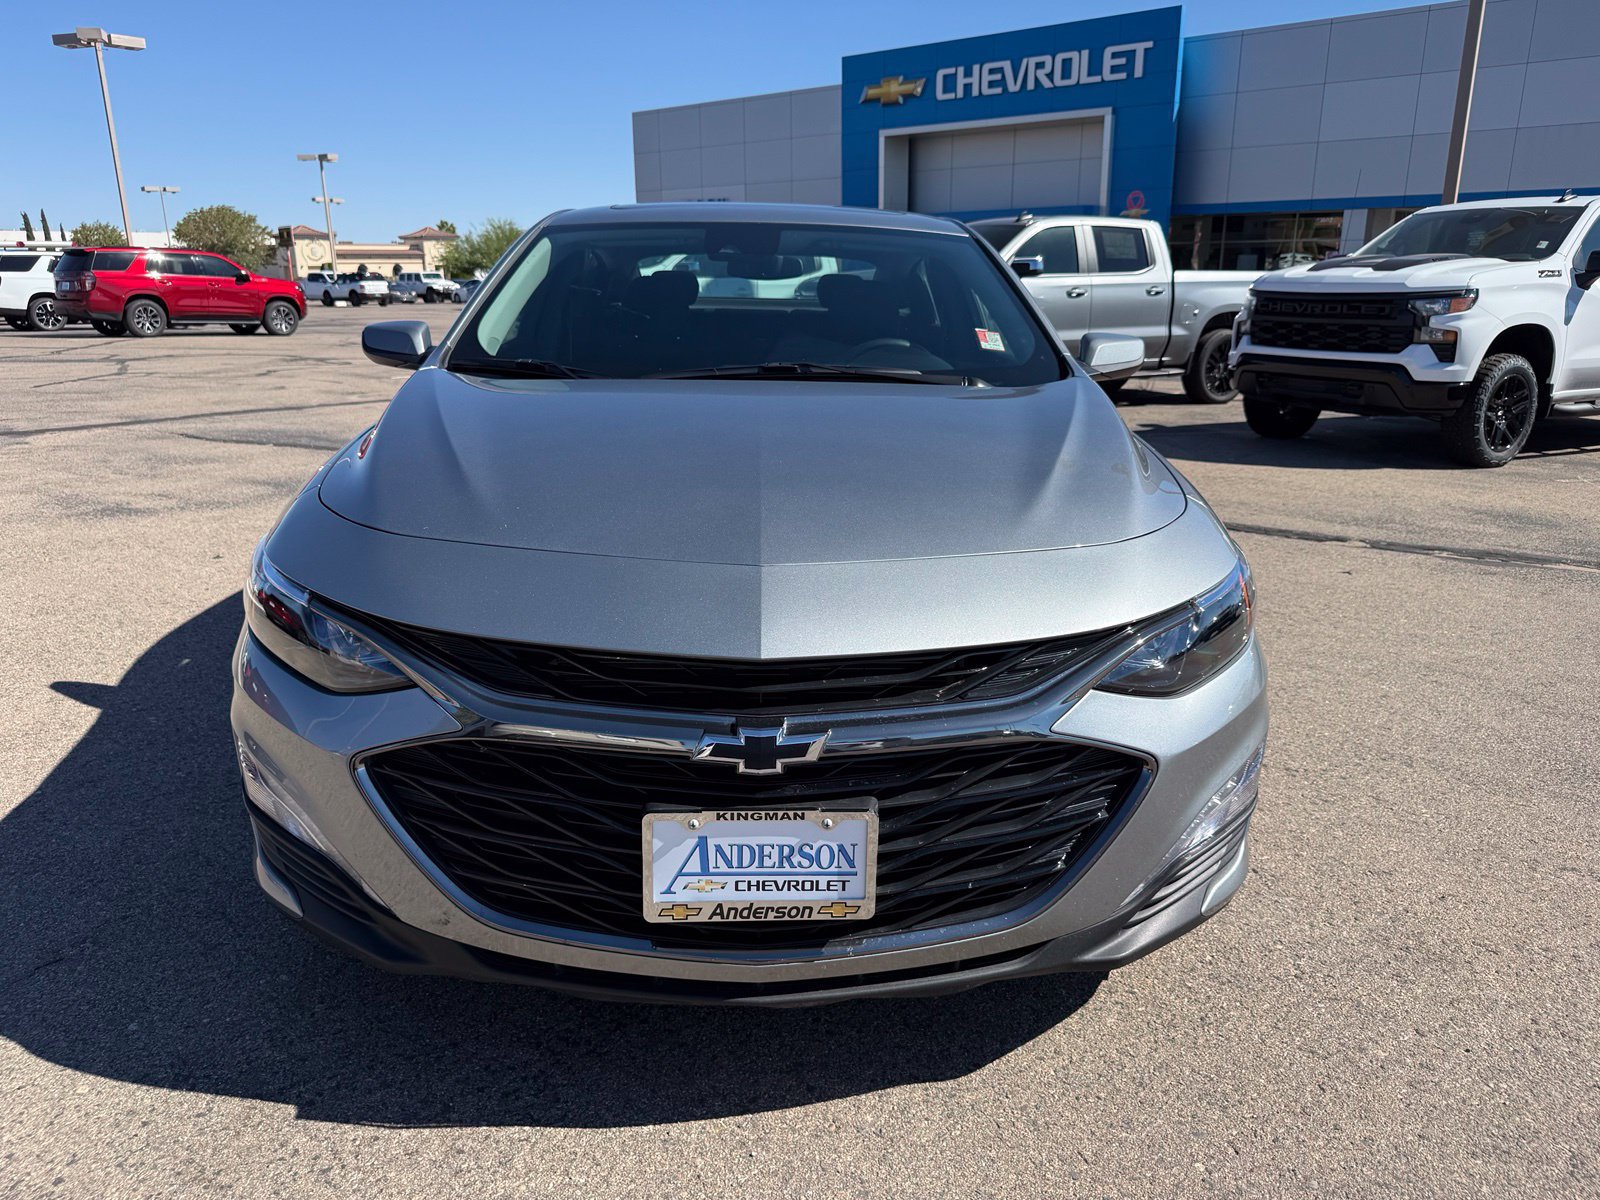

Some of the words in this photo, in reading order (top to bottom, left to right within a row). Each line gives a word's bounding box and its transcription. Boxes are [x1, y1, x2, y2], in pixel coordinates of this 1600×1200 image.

[936, 41, 1154, 101] CHEVROLET
[1257, 301, 1391, 315] CHEVROLET
[716, 812, 806, 821] KINGMAN
[660, 835, 858, 894] ANDERSON
[734, 880, 851, 892] CHEVROLET
[708, 903, 813, 920] Anderson
